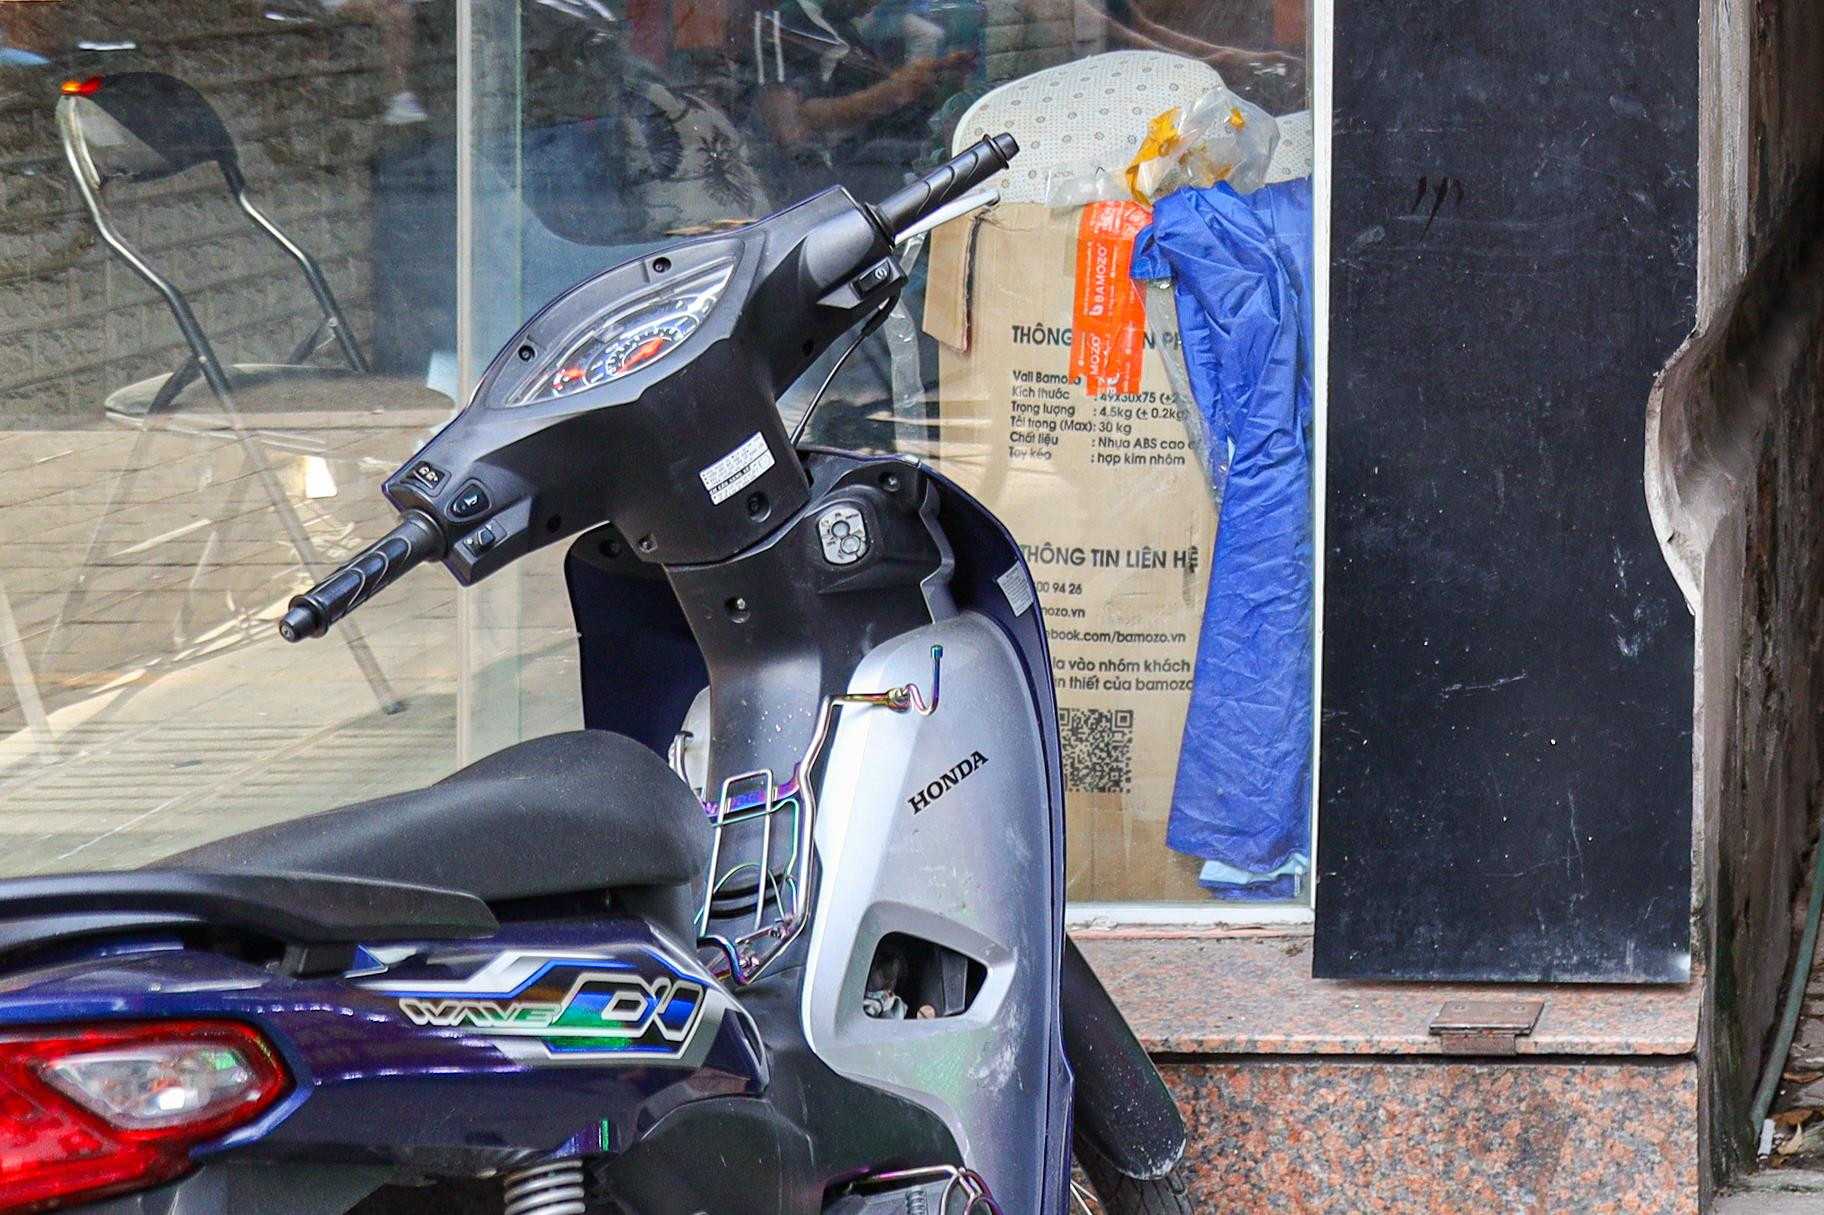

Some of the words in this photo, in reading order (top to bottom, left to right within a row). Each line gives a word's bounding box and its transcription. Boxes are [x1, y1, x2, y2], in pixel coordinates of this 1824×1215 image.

[1011, 321, 1073, 347] THÔNG
[1011, 400, 1040, 416] Trọng
[1043, 402, 1076, 418] lượng
[1099, 421, 1113, 433] 30
[1116, 421, 1132, 436] kg
[1098, 436, 1131, 450] Nhựa
[1134, 437, 1158, 450] ABS
[1160, 440, 1185, 450] cao
[1097, 451, 1121, 466] hợp
[1124, 453, 1147, 465] kim
[1149, 453, 1186, 465] nhôm
[1091, 547, 1120, 568] TIN
[1126, 545, 1168, 569] LIÊN
[1052, 582, 1066, 595] 94
[1068, 583, 1083, 595] 26
[1068, 656, 1096, 672] vào
[1099, 657, 1141, 673] nhóm
[1144, 658, 1191, 673] khách
[1069, 674, 1100, 691] thiết
[1103, 676, 1132, 691] của
[907, 750, 989, 815] HONDA
[399, 996, 562, 1028] WAVE
